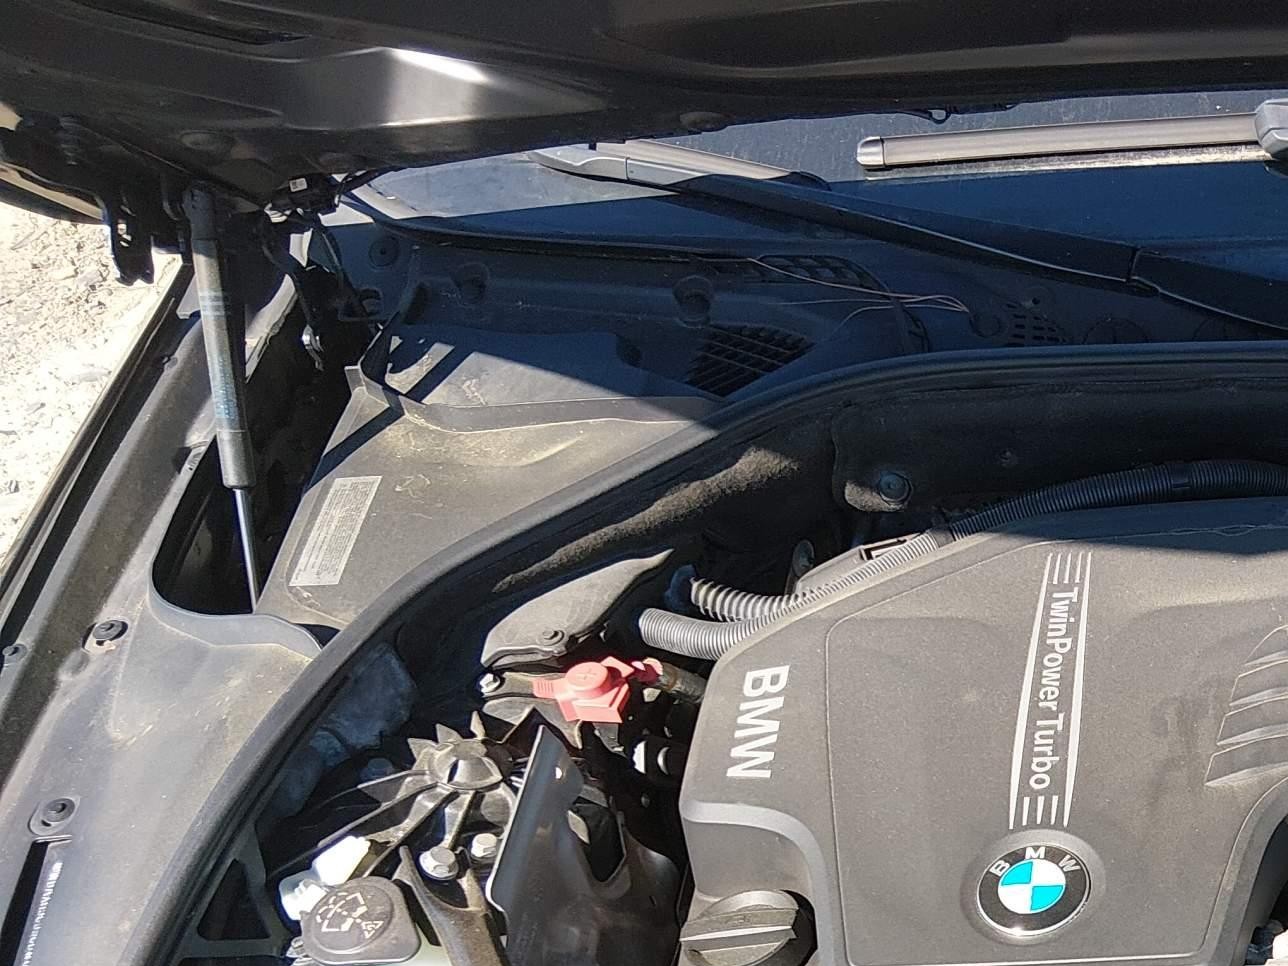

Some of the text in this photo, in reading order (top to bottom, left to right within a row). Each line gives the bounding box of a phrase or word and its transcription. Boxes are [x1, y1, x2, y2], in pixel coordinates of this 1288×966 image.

[726, 665, 790, 779] BMW
[1029, 586, 1079, 790] TwinPower Turbo
[988, 846, 1082, 878] BMW
